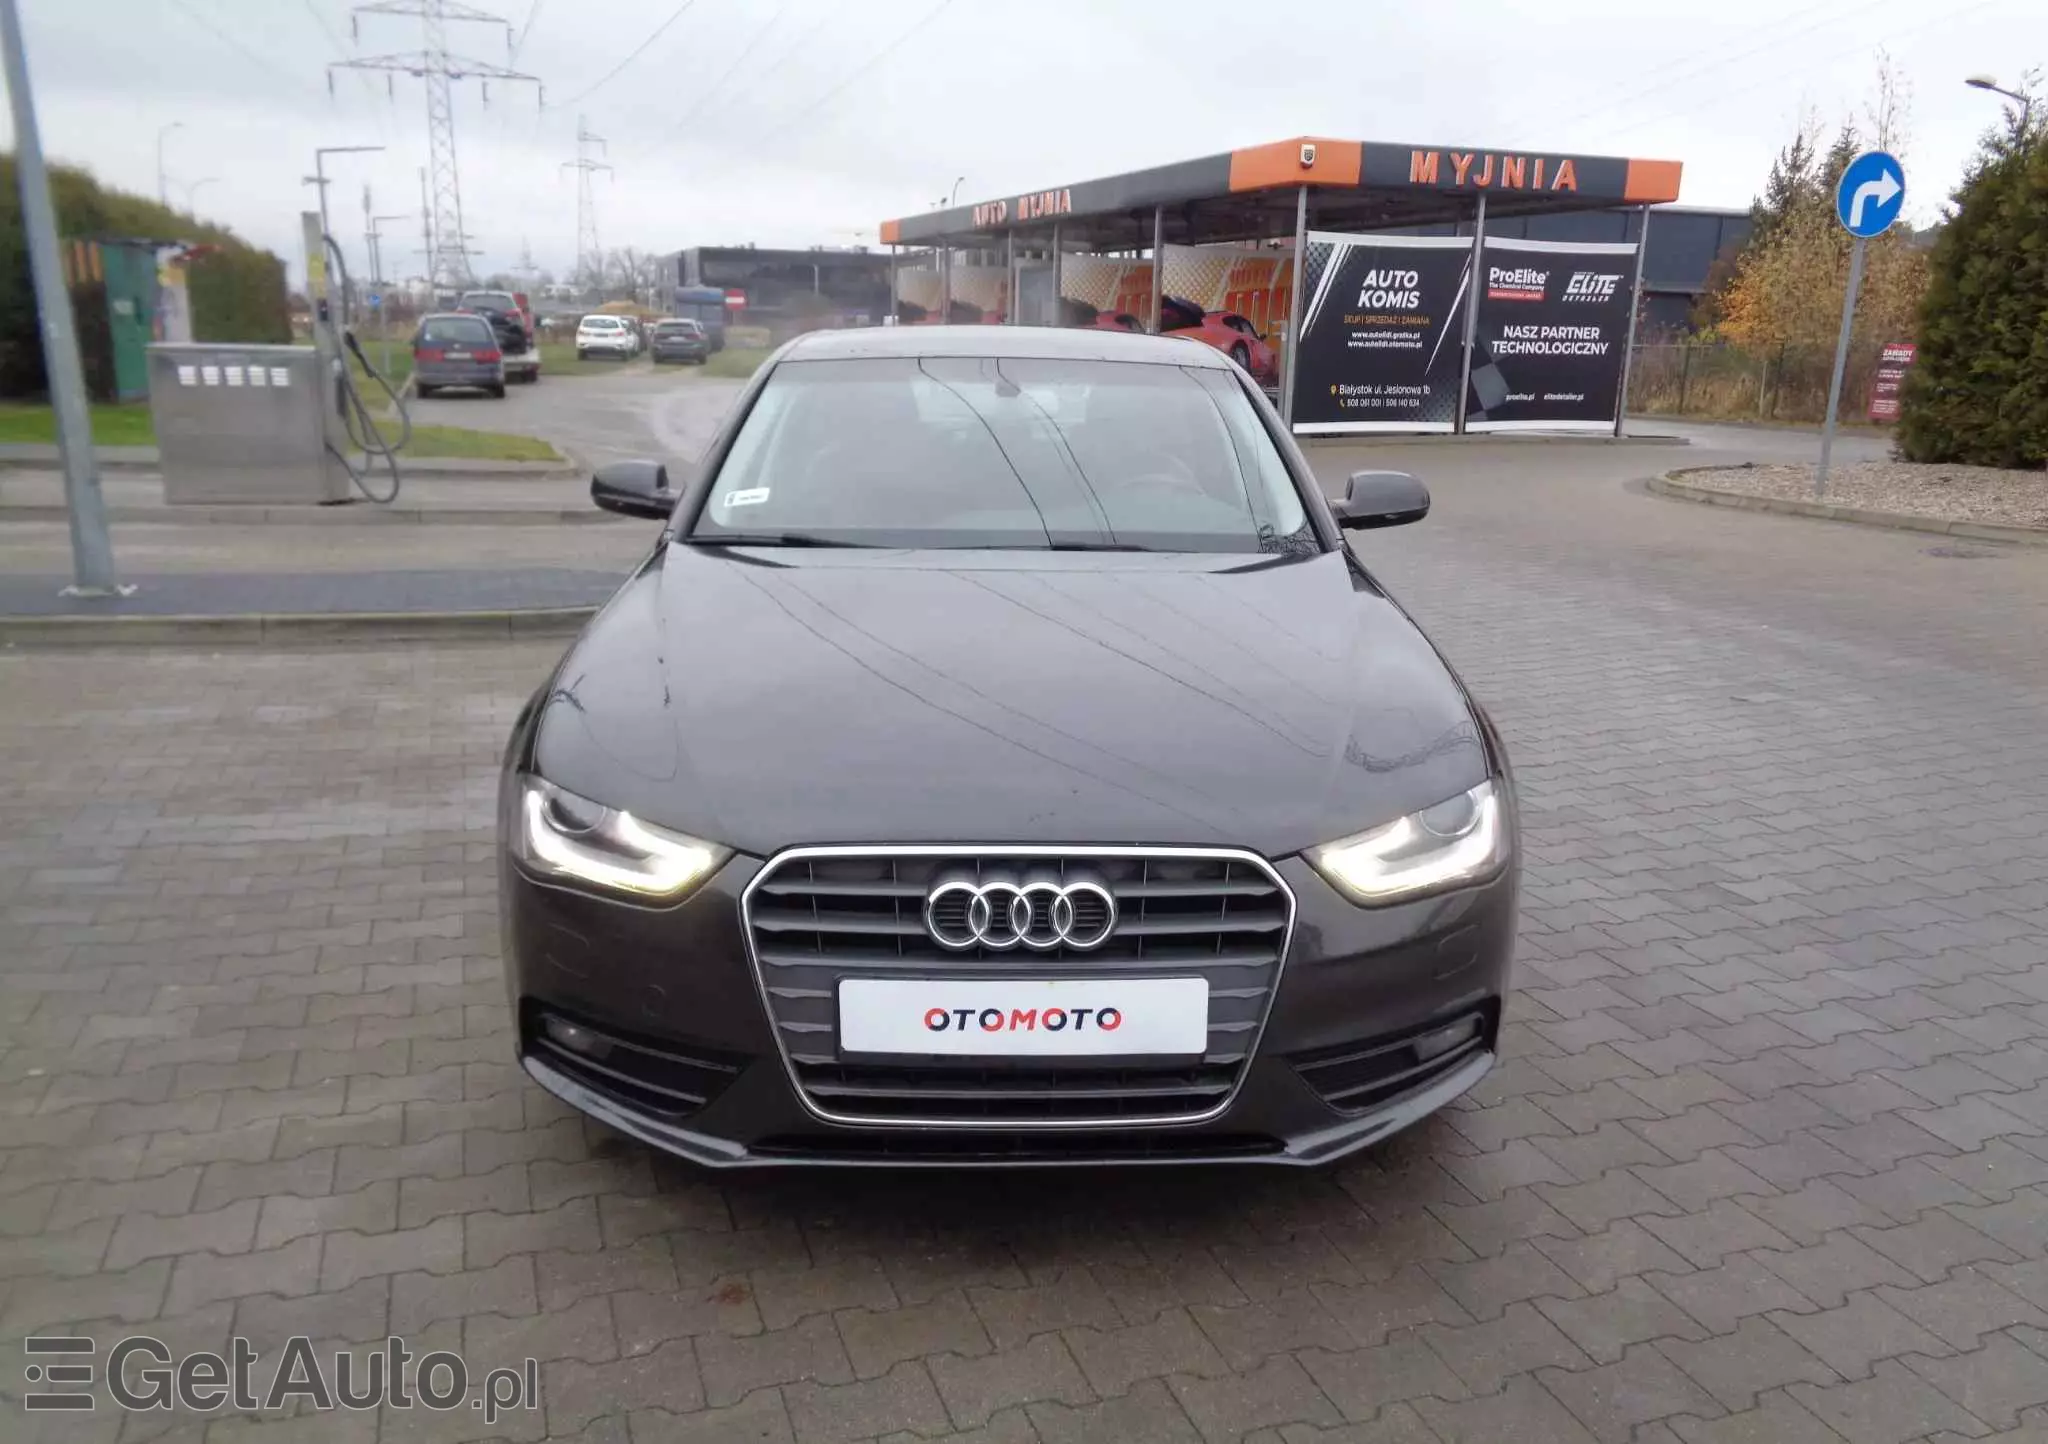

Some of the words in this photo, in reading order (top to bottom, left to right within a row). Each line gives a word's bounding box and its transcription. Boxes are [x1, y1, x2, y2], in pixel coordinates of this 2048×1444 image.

[1409, 150, 1577, 191] MYJNIA
[973, 200, 1007, 228] AUTO
[1018, 189, 1072, 220] MYJNIA
[1363, 269, 1419, 288] AUTO
[1489, 267, 1546, 285] ProElite
[1357, 290, 1421, 308] KOMIS
[1503, 325, 1539, 339] NASZ
[1541, 326, 1600, 340] PARTNER
[1492, 340, 1609, 355] TECHNOLOGICZNY
[1339, 384, 1373, 396] Białystok
[924, 1007, 1122, 1032] OTOMOTO
